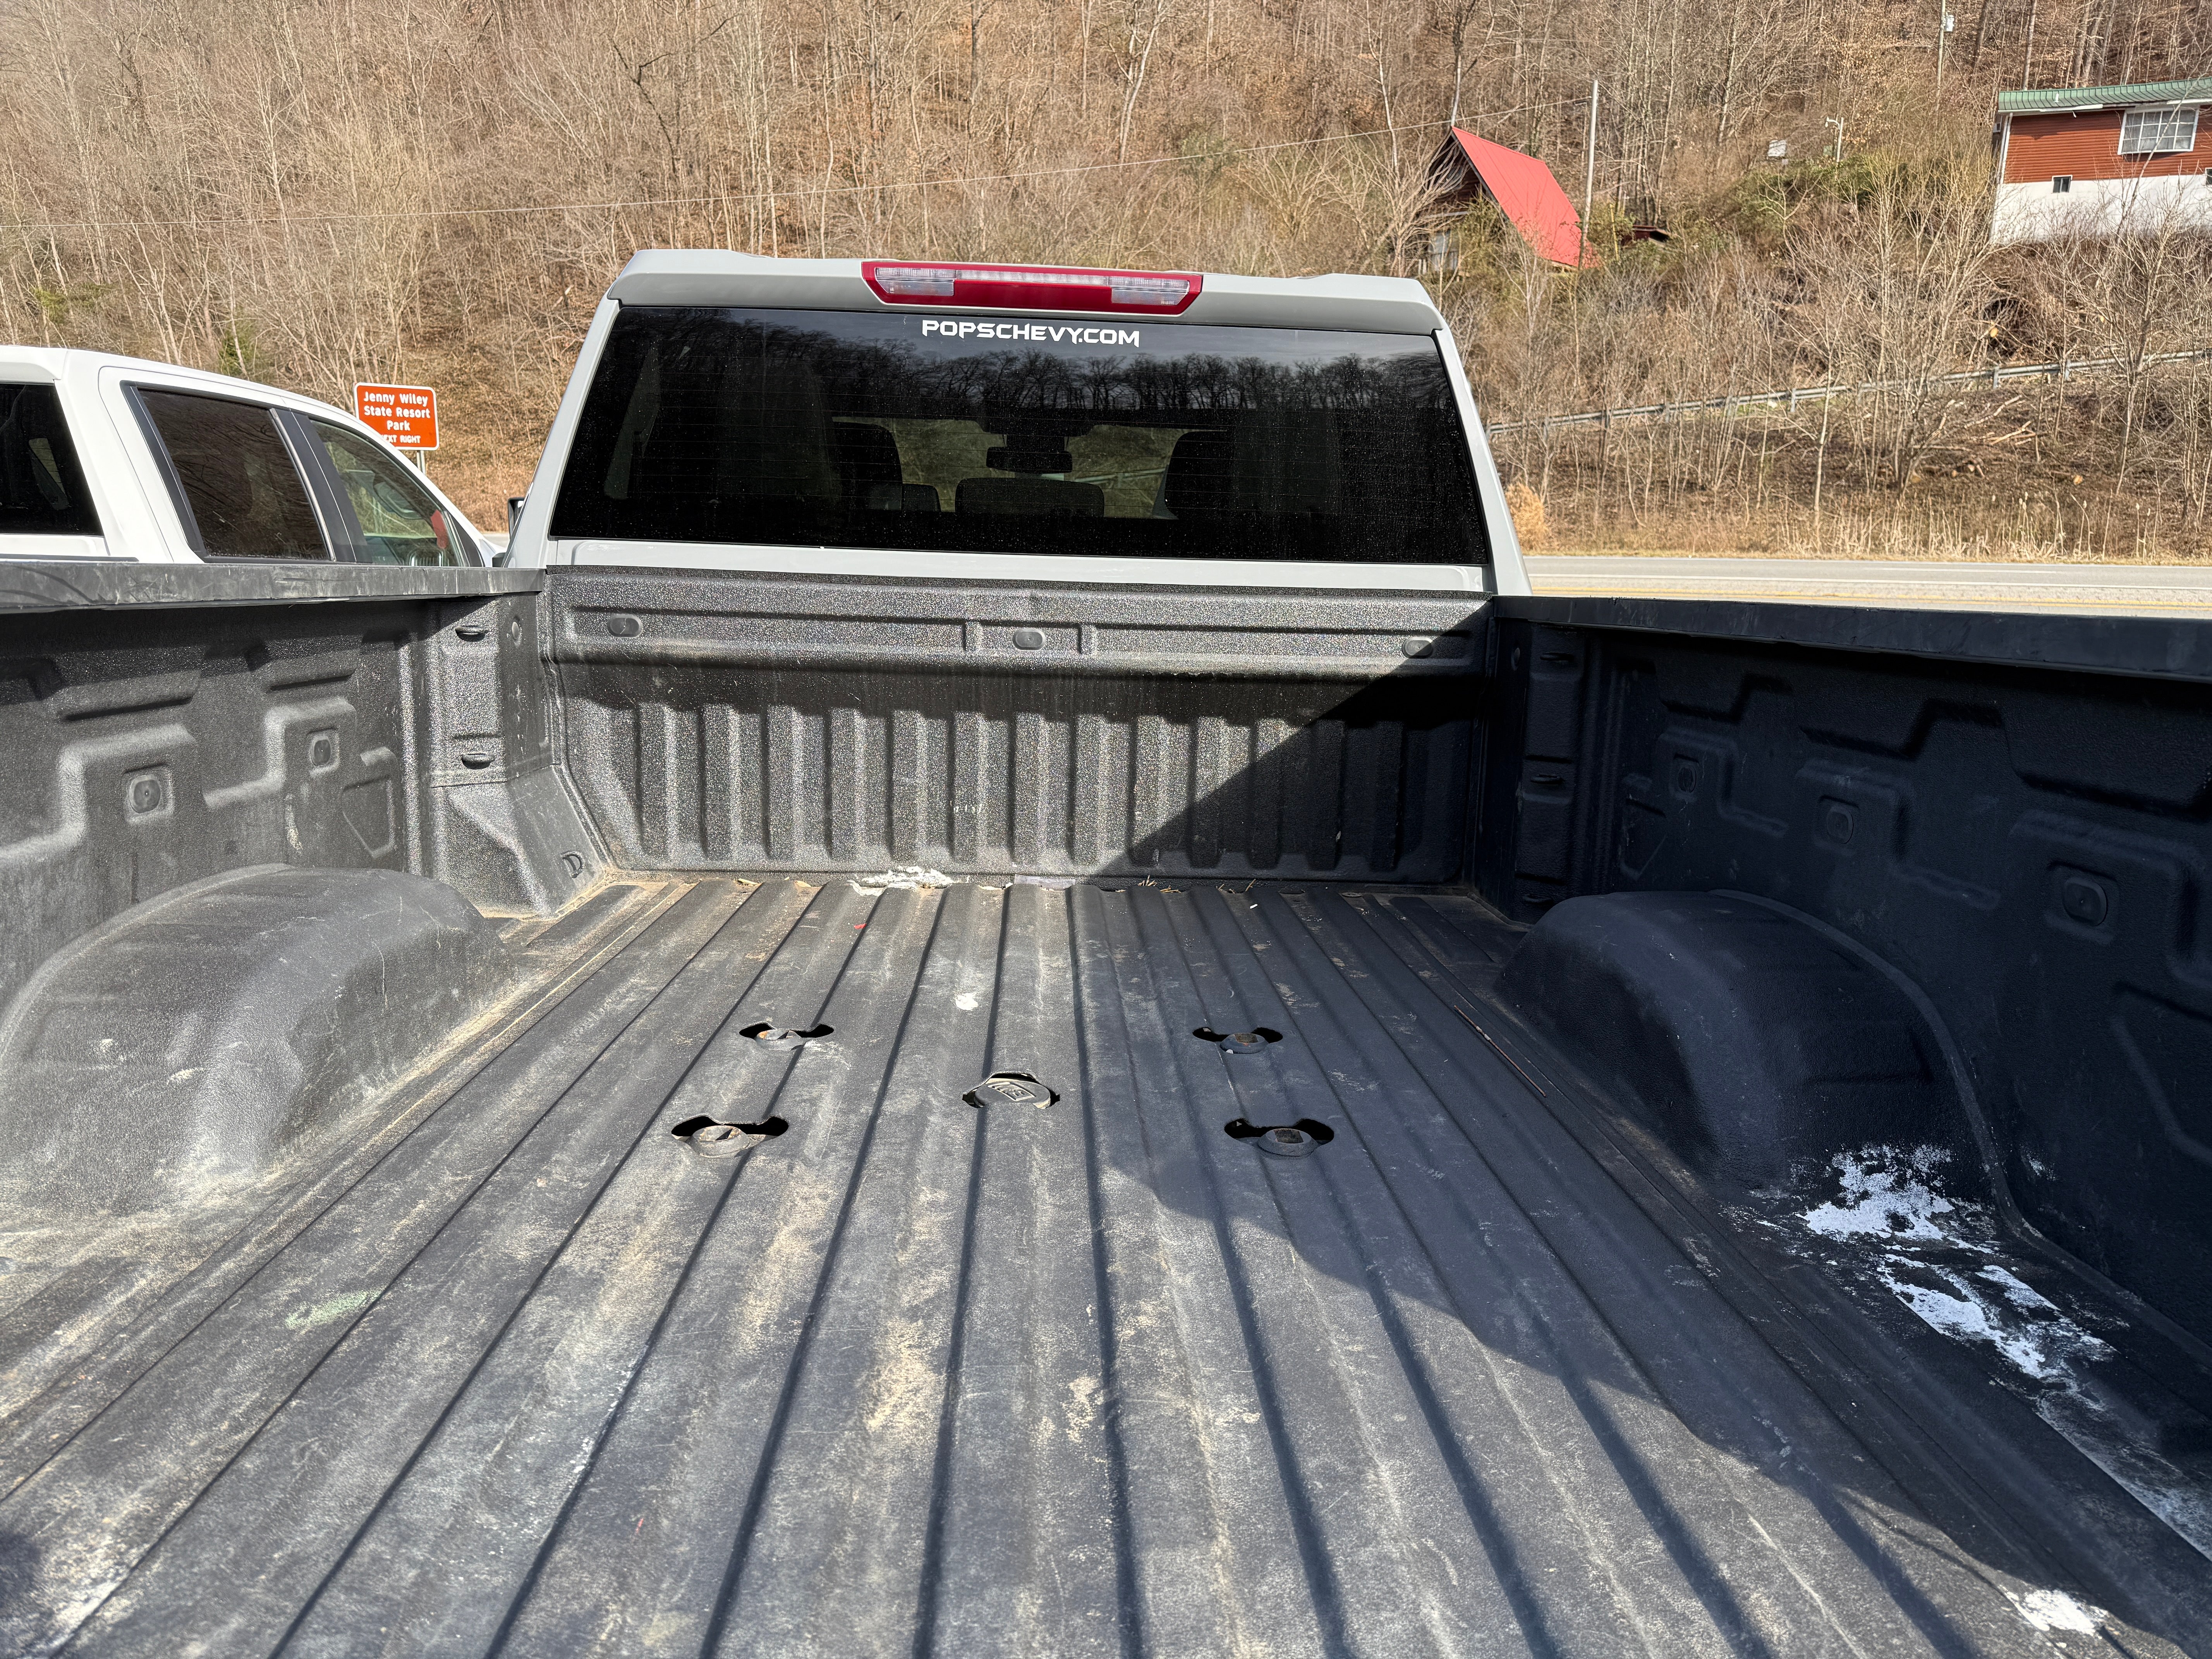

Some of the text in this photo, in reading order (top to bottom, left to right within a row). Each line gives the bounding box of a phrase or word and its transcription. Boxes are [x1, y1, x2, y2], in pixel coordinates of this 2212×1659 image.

[922, 320, 1140, 348] POPSCHEVY.COM
[364, 391, 428, 407] Jenny Wiley
[364, 405, 430, 418] State Resort
[386, 420, 410, 431] Park
[400, 435, 421, 443] RIGHT
